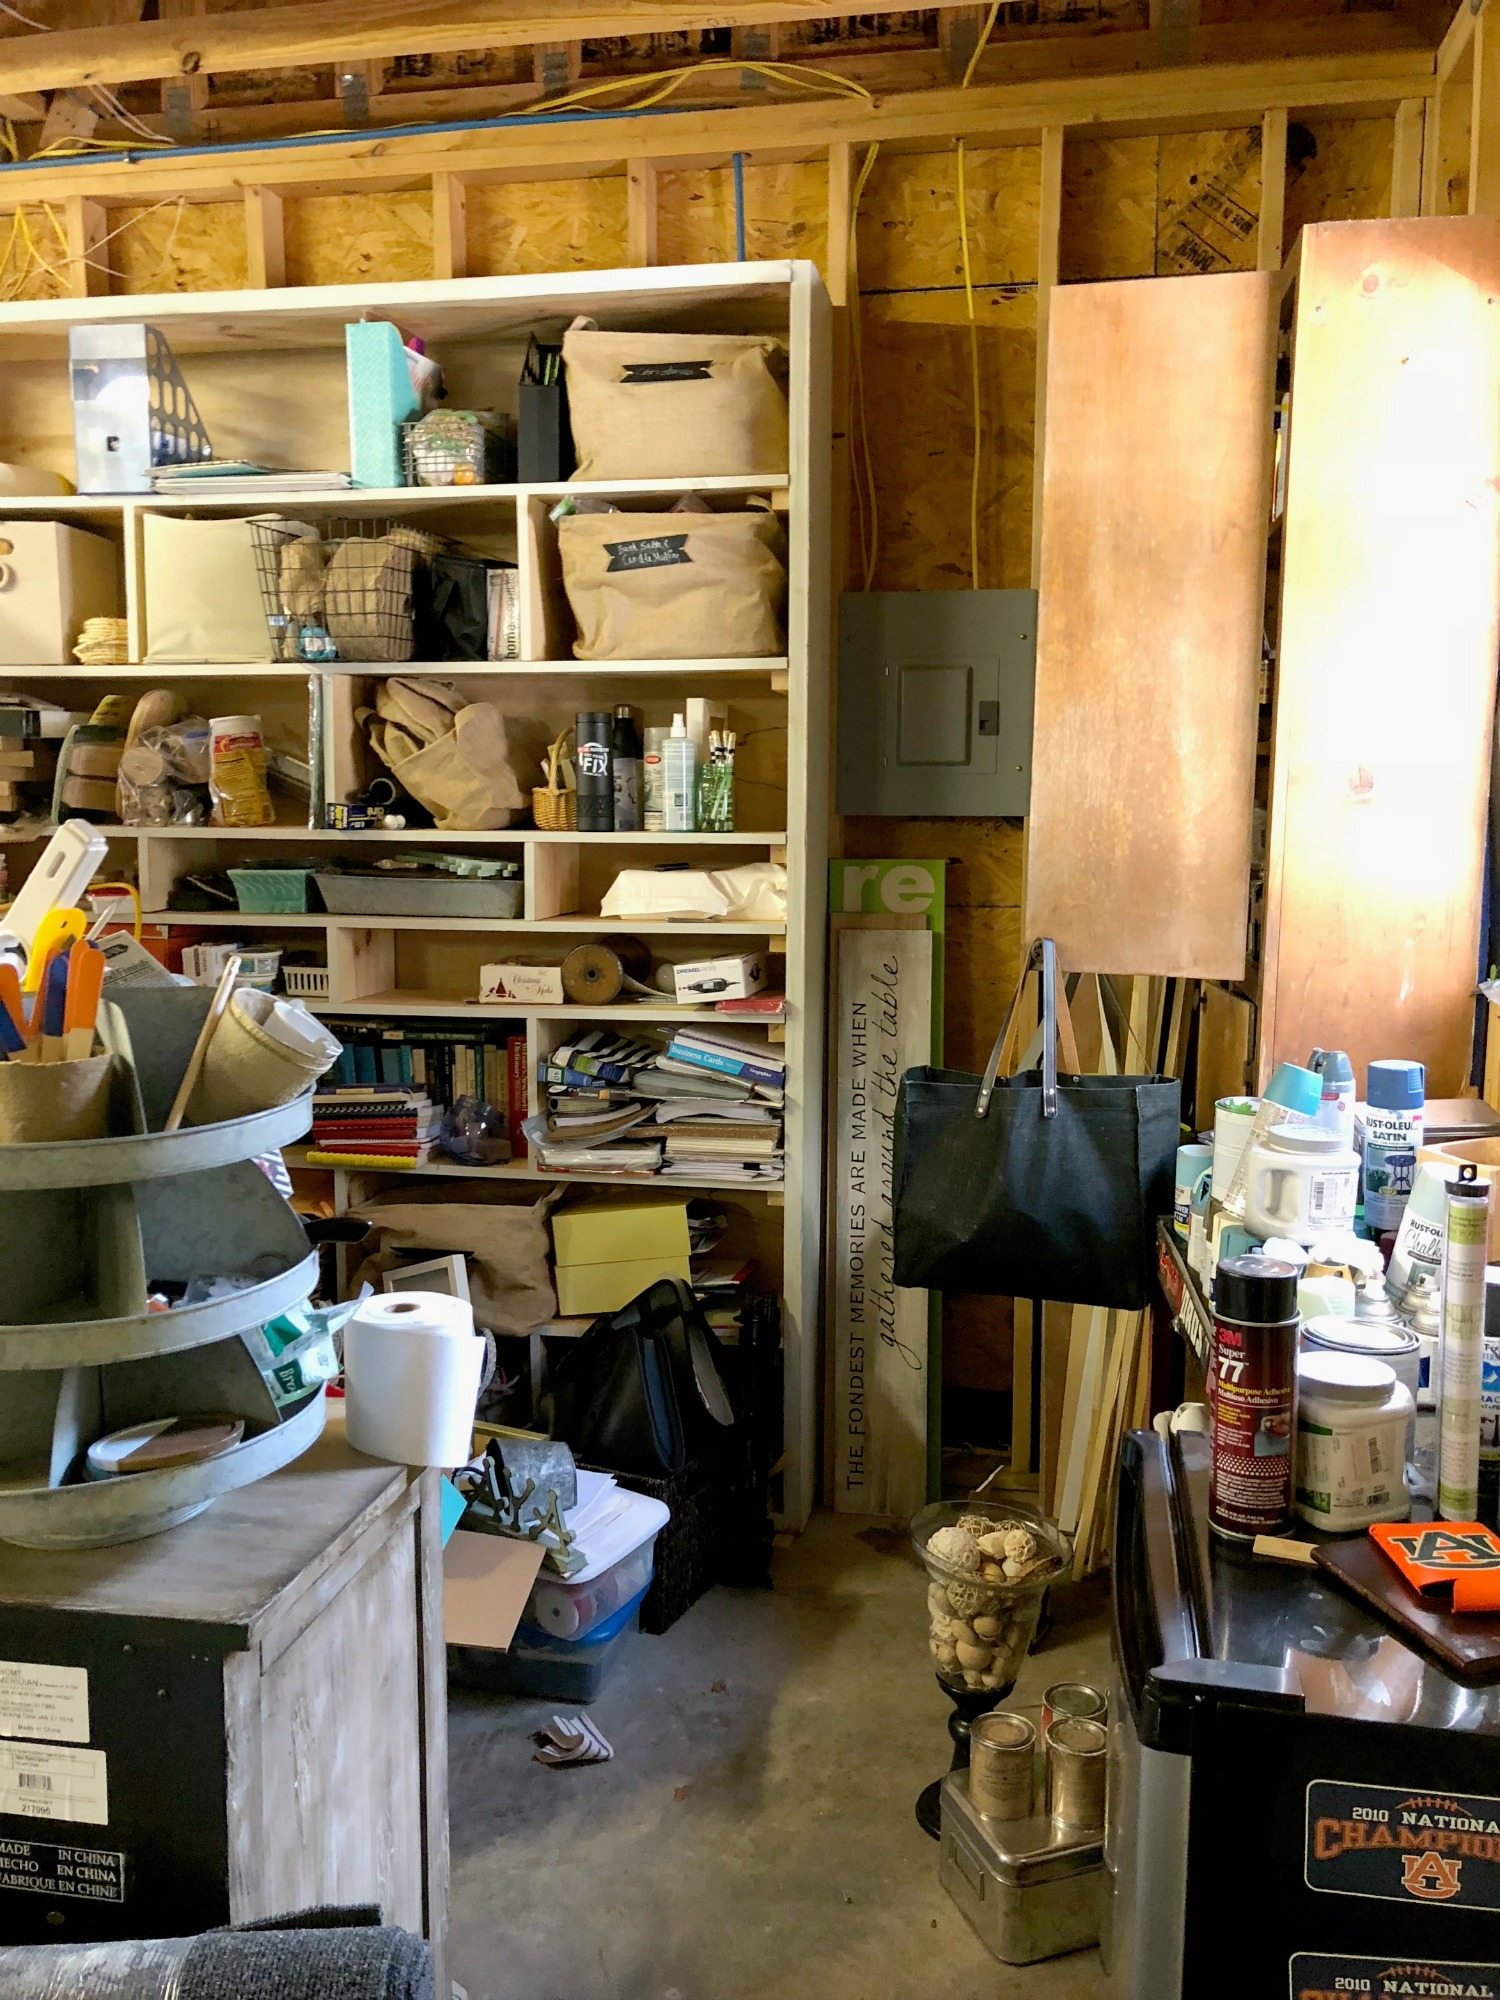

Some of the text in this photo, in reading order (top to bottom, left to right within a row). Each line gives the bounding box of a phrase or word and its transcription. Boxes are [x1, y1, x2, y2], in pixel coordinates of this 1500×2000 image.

[583, 757, 608, 776] FIX
[843, 864, 935, 913] re
[671, 1045, 702, 1060] Business
[703, 1054, 724, 1066] Cards
[1372, 1130, 1408, 1142] SATIN
[869, 956, 923, 1371] gathered around the table
[847, 1002, 867, 1490] THE FONDEST MEMORIES ARE MADE WHEN
[1218, 1327, 1242, 1347] 3M
[1218, 1343, 1246, 1359] Super
[1218, 1355, 1245, 1384] 77
[1218, 1379, 1262, 1396] Multipurpose
[1352, 1807, 1389, 1822] 2010
[58, 1849, 72, 1861] IN
[74, 1851, 116, 1867] CHINA
[57, 1864, 73, 1877] EN
[76, 1866, 117, 1883] CHINA
[0, 1873, 119, 1898] ABRIQUE EN CHINE
[1334, 1976, 1371, 1991] 2010
[1383, 1980, 1493, 1998] NATIONAL
